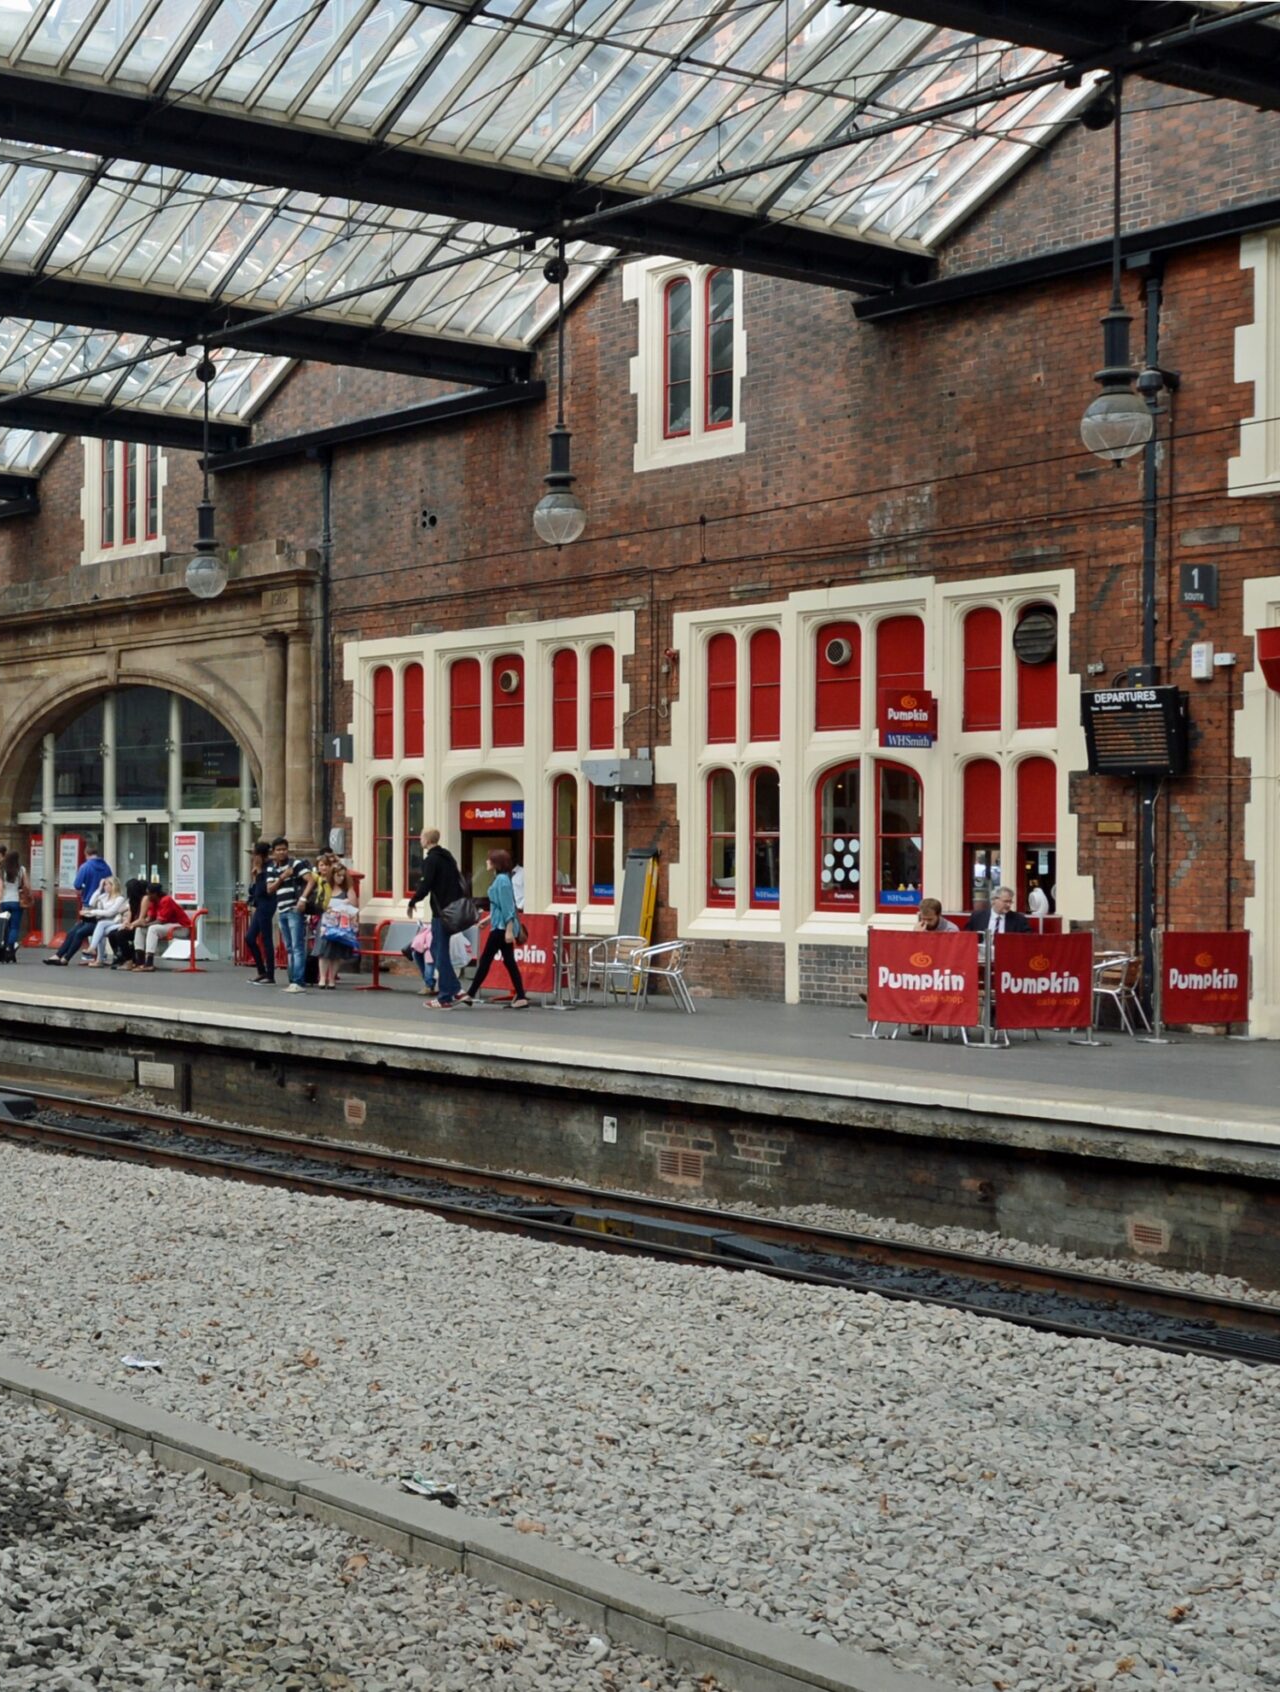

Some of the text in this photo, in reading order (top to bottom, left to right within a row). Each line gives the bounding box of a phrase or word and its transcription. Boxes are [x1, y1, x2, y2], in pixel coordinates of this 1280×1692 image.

[1192, 567, 1199, 589] 1
[1183, 592, 1204, 601] SOUTH
[1094, 690, 1157, 704] DEPARTURES
[887, 707, 929, 722] Pumpkin
[332, 737, 341, 758] 1
[887, 734, 930, 747] WHSmith
[475, 808, 506, 818] Pumpkin
[878, 966, 965, 991] Pumpkin
[1001, 971, 1080, 994] Pumpkin
[1169, 968, 1238, 989] Pumpkin
